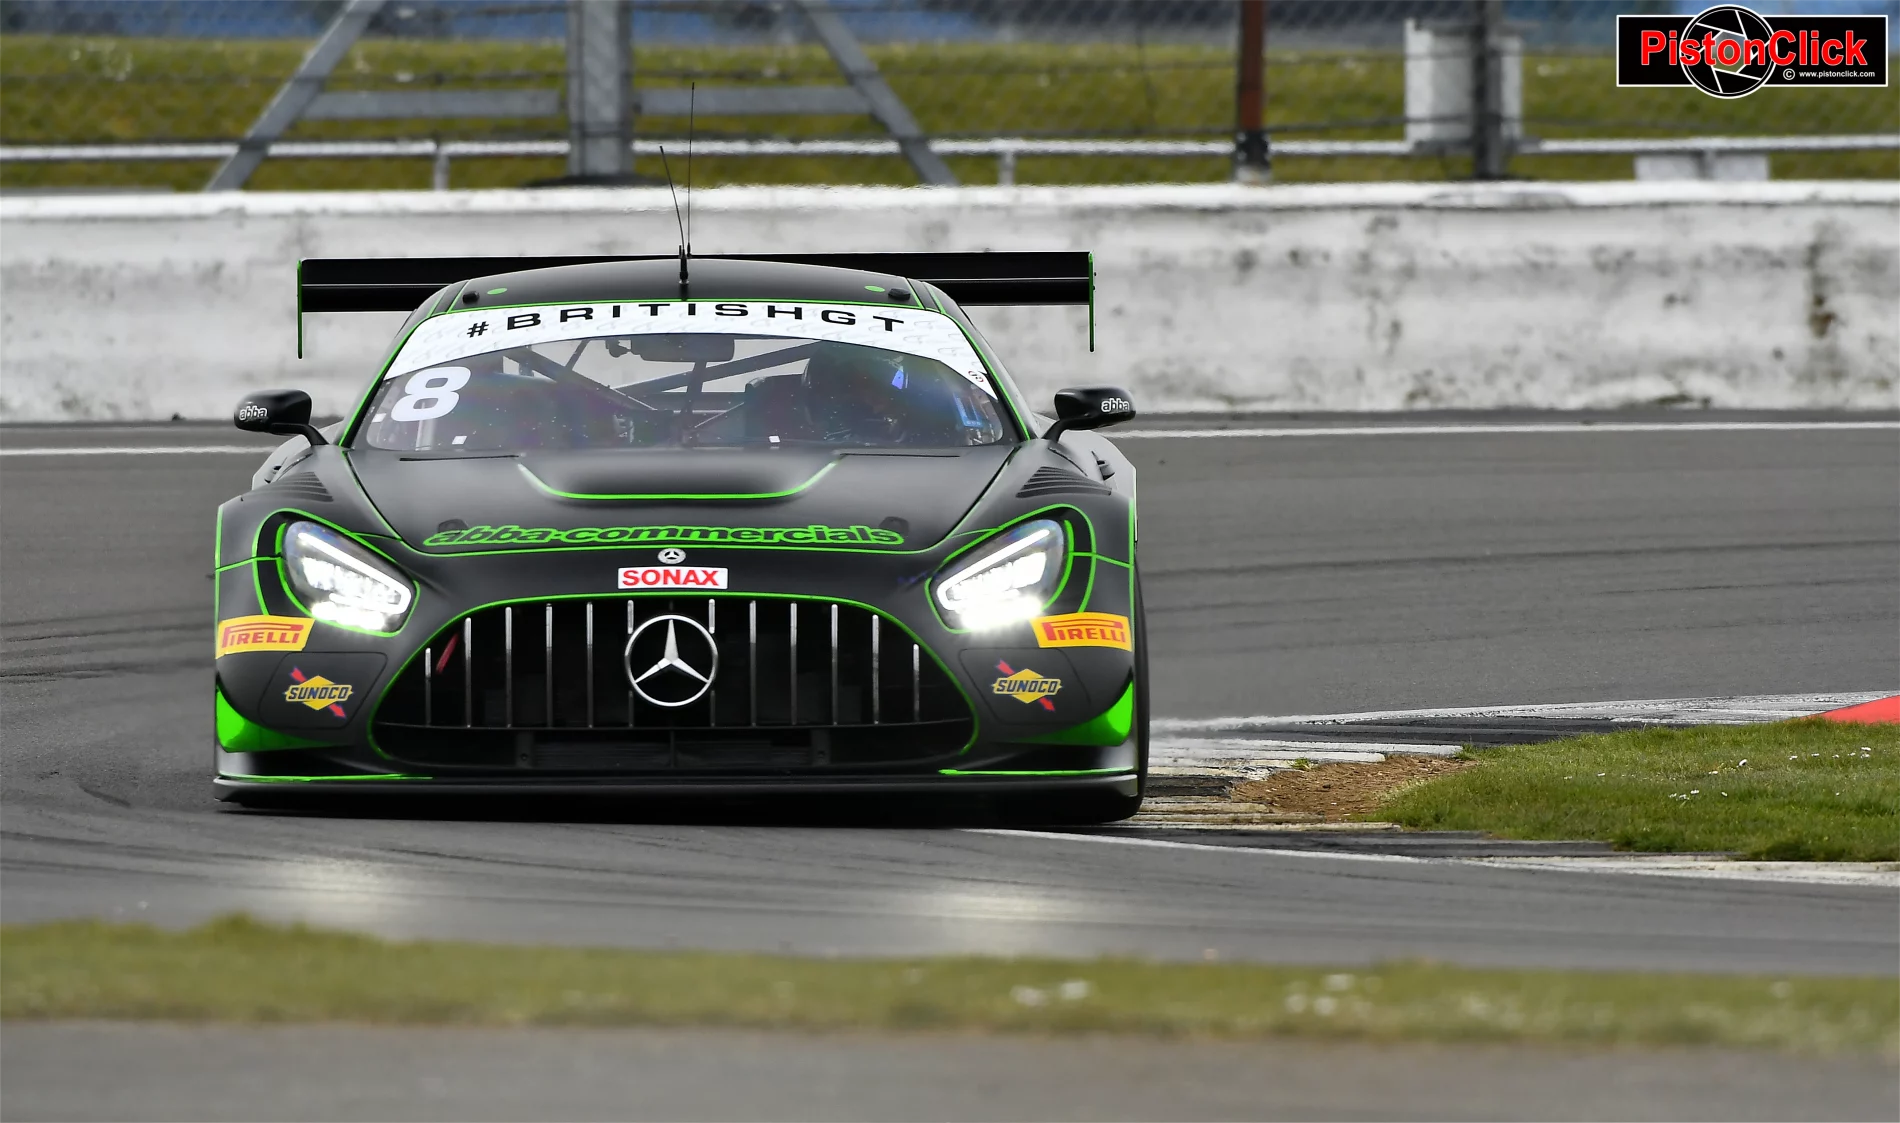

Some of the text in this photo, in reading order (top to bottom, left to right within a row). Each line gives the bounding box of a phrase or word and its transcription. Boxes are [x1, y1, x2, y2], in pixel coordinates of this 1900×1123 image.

[466, 302, 904, 338] #BRITISHGT
[390, 366, 472, 422] 8
[239, 405, 268, 420] abba
[1101, 397, 1130, 412] abba
[622, 569, 720, 587] SONAX
[221, 622, 304, 649] PIRELLI
[1041, 618, 1127, 643] PIRELLI
[287, 686, 350, 700] SUNOCO
[996, 679, 1059, 694] SUNOCO
